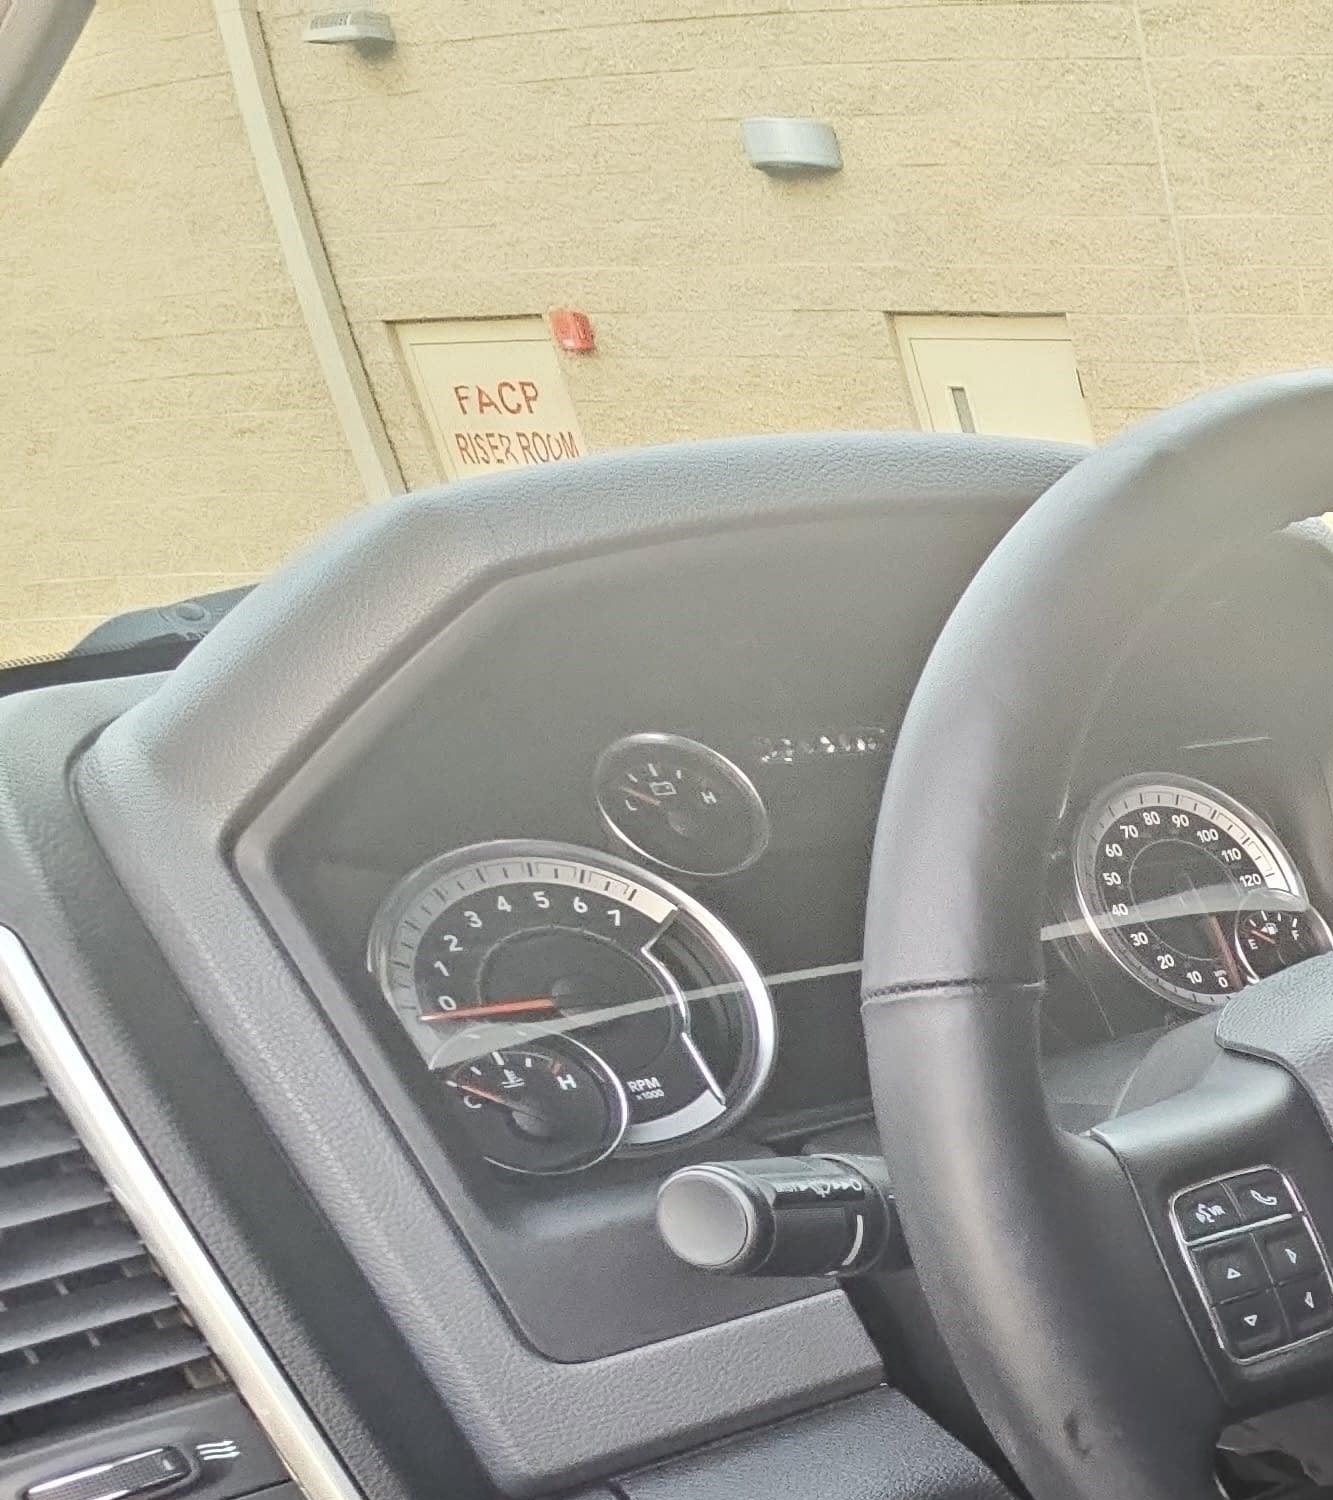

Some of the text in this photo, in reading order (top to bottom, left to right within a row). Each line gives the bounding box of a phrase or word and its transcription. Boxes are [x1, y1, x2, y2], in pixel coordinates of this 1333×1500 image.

[453, 381, 539, 415] FACP
[455, 431, 580, 465] RISER ROOM
[1142, 811, 1161, 826] 80
[1171, 813, 1190, 829] 90
[1119, 824, 1139, 840] 70
[1196, 827, 1219, 844] 100
[1105, 843, 1123, 859] 60
[1222, 847, 1242, 863] 110
[1103, 871, 1122, 887] 50
[1239, 871, 1262, 888] 120
[496, 895, 513, 914] 4
[533, 890, 550, 909] 5
[572, 896, 589, 914] 6
[607, 909, 622, 926] 7
[1111, 902, 1130, 917] 40
[464, 910, 484, 929] 3
[443, 934, 464, 953] 2
[1129, 930, 1149, 948] 30
[1155, 952, 1176, 970] 20
[1185, 968, 1203, 985] 10
[1218, 976, 1229, 988] 0
[438, 994, 457, 1012] 0
[627, 1076, 662, 1092] RPM
